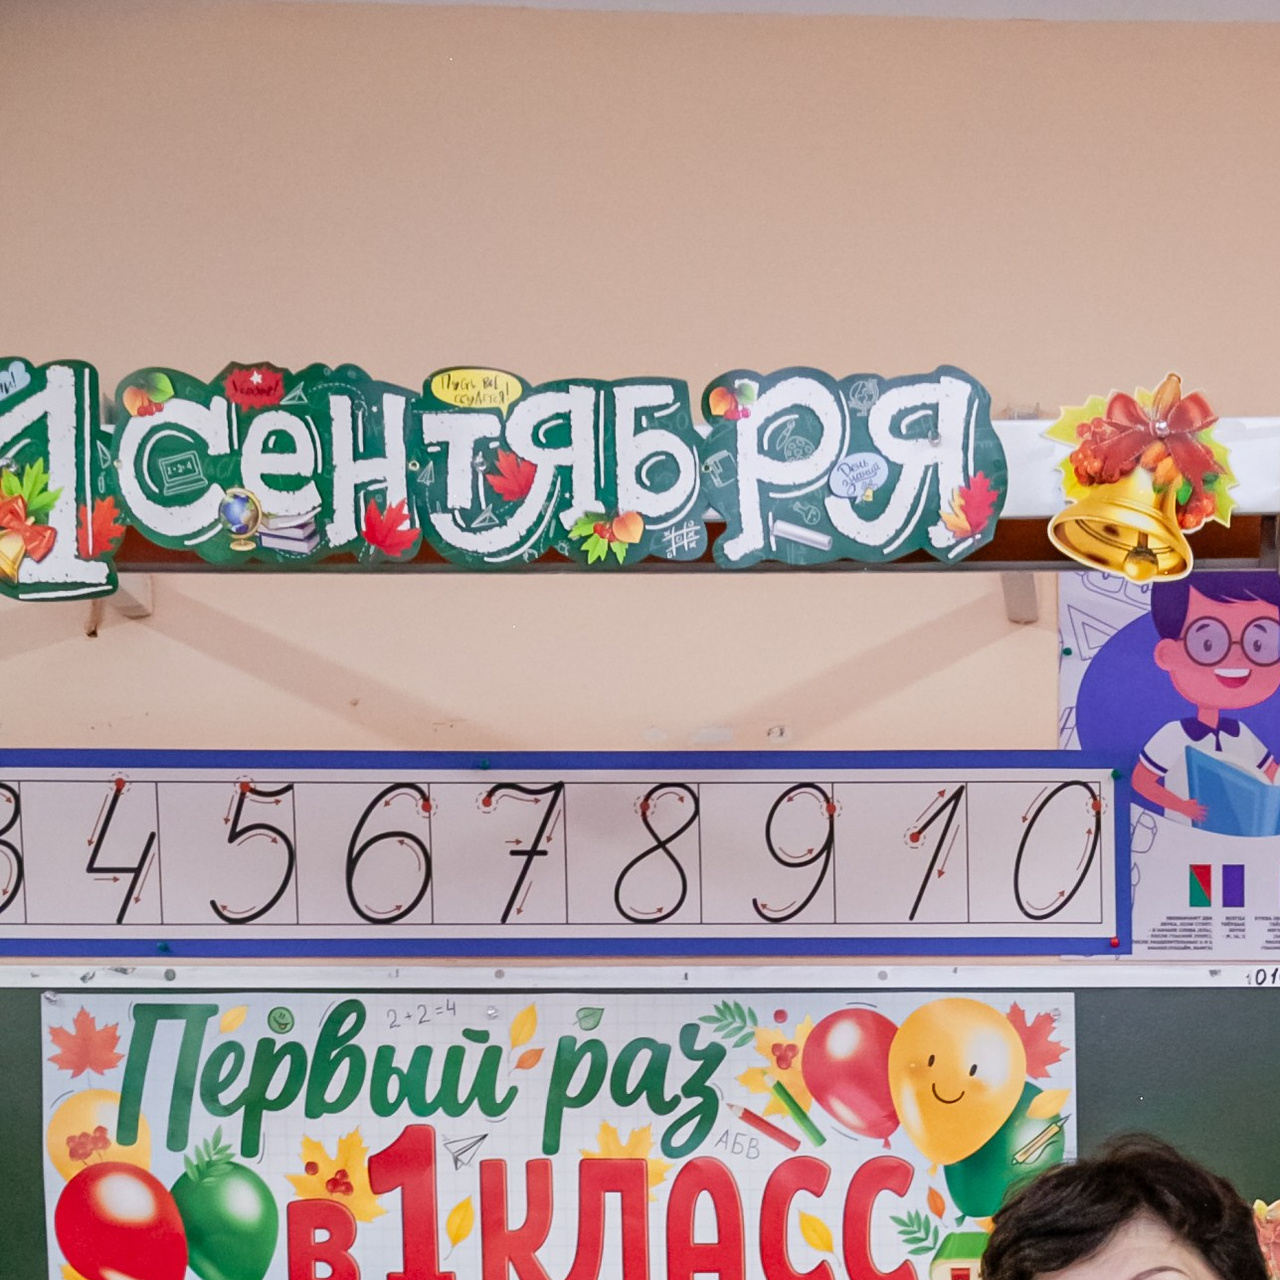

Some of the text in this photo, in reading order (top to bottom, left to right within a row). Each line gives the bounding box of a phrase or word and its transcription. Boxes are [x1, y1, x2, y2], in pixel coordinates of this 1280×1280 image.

[0, 365, 109, 584] 1
[86, 780, 157, 925] 4
[210, 781, 296, 924] 5
[346, 780, 433, 924] 6
[486, 780, 566, 924] 7
[614, 780, 700, 923] 8
[752, 780, 836, 922] 9
[116, 999, 727, 1158] Первый раз
[714, 1129, 760, 1160] АБВ
